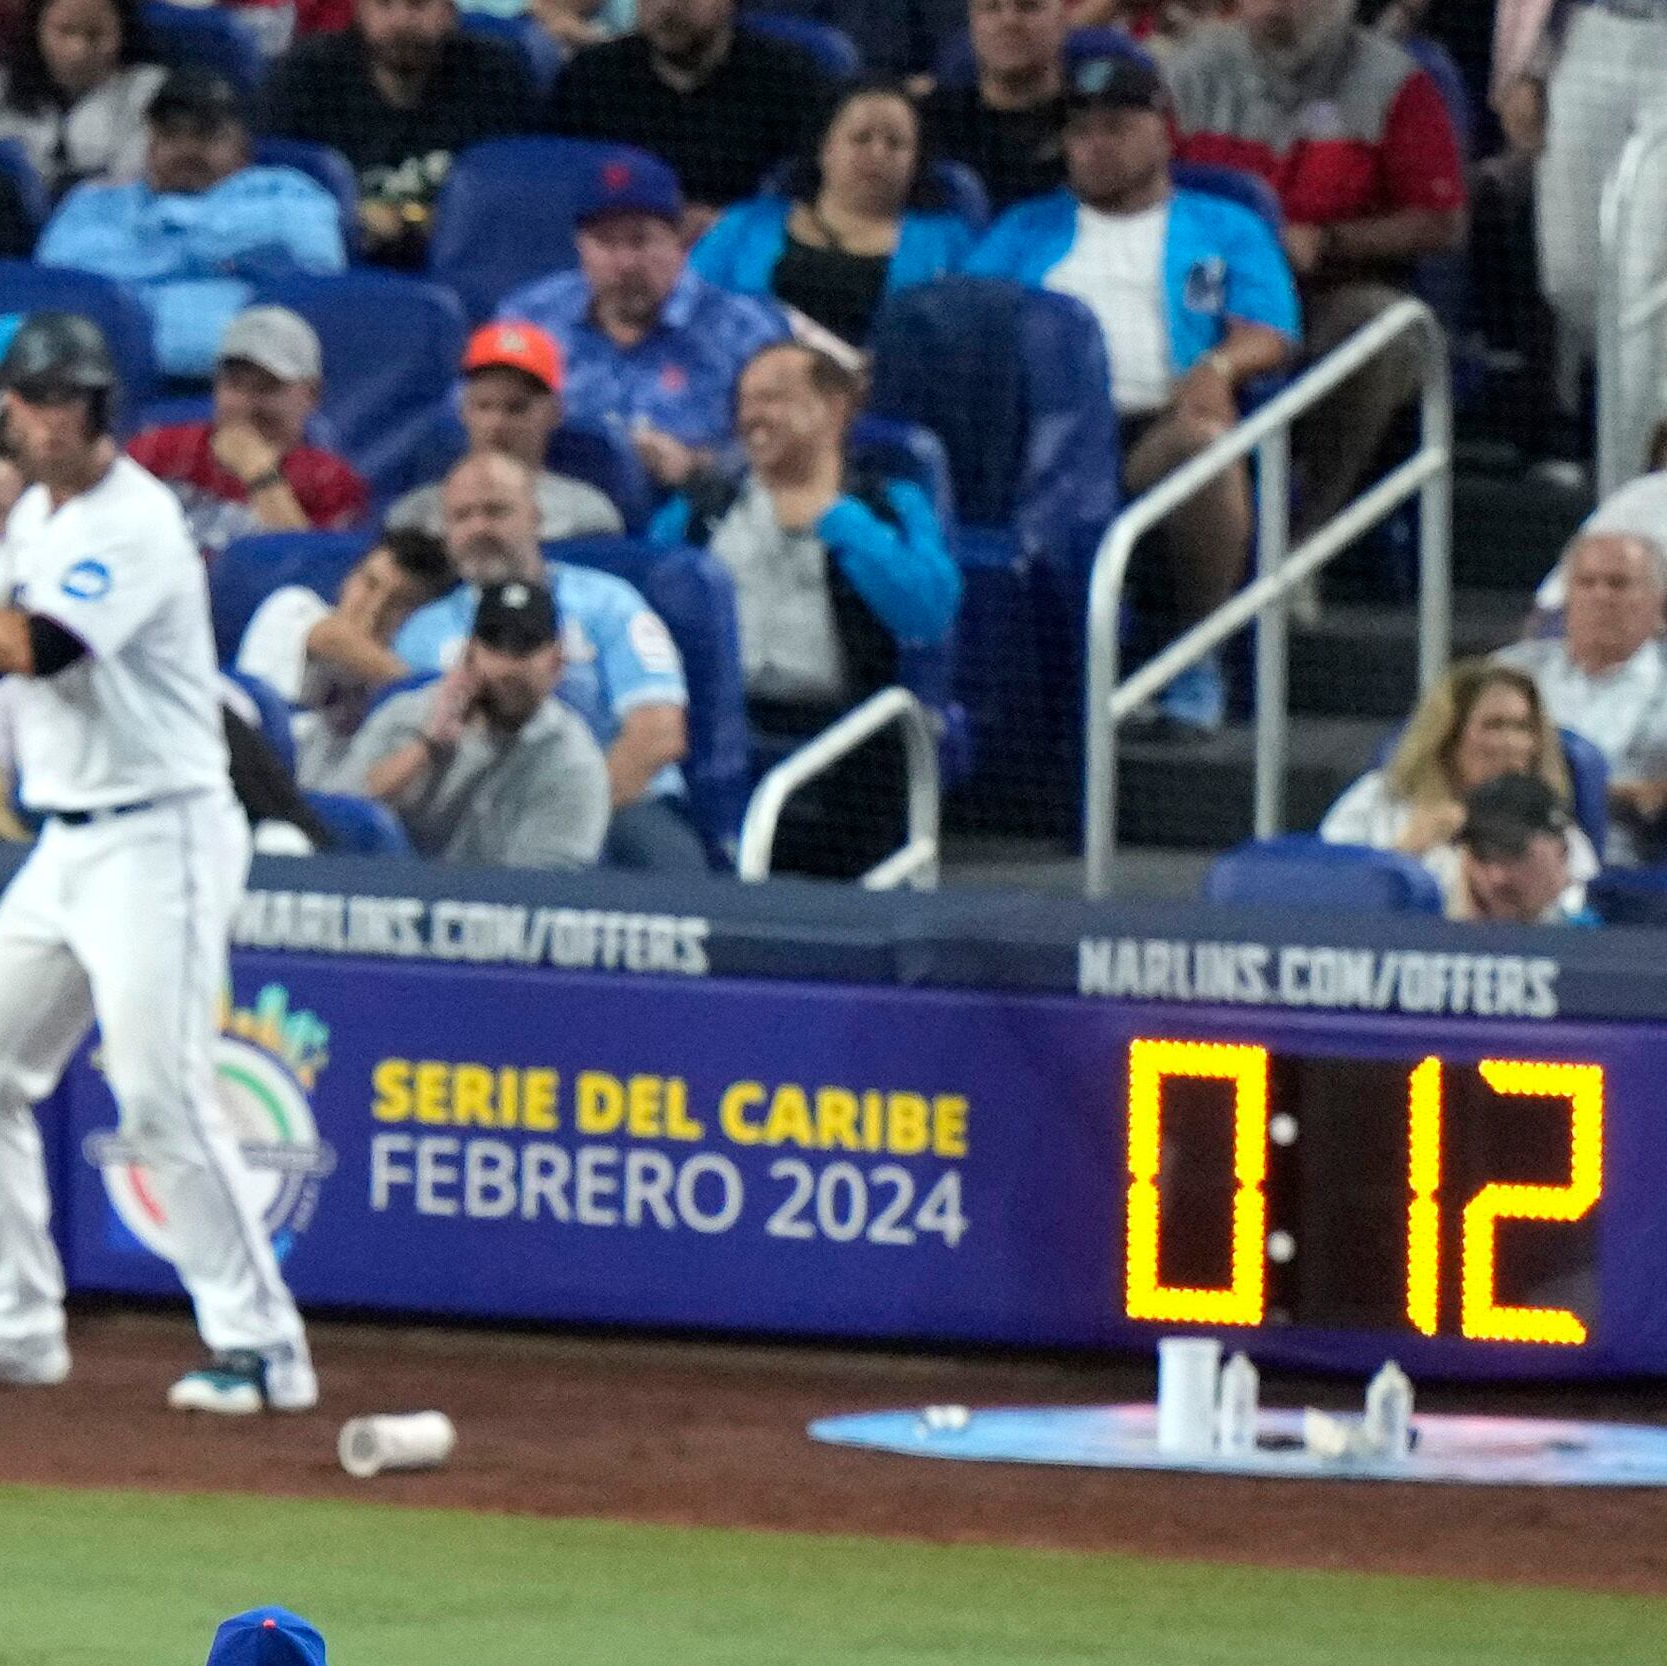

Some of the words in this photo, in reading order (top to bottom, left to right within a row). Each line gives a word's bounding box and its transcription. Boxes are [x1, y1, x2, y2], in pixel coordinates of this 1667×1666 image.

[1078, 938, 1561, 1019] MARLINS.COM/OFFERS
[372, 1058, 558, 1133] SERIE
[576, 1069, 703, 1140] DEL
[721, 1078, 970, 1159] CARIBE
[370, 1133, 744, 1232] FEBRERO
[768, 1158, 970, 1249] 2024
